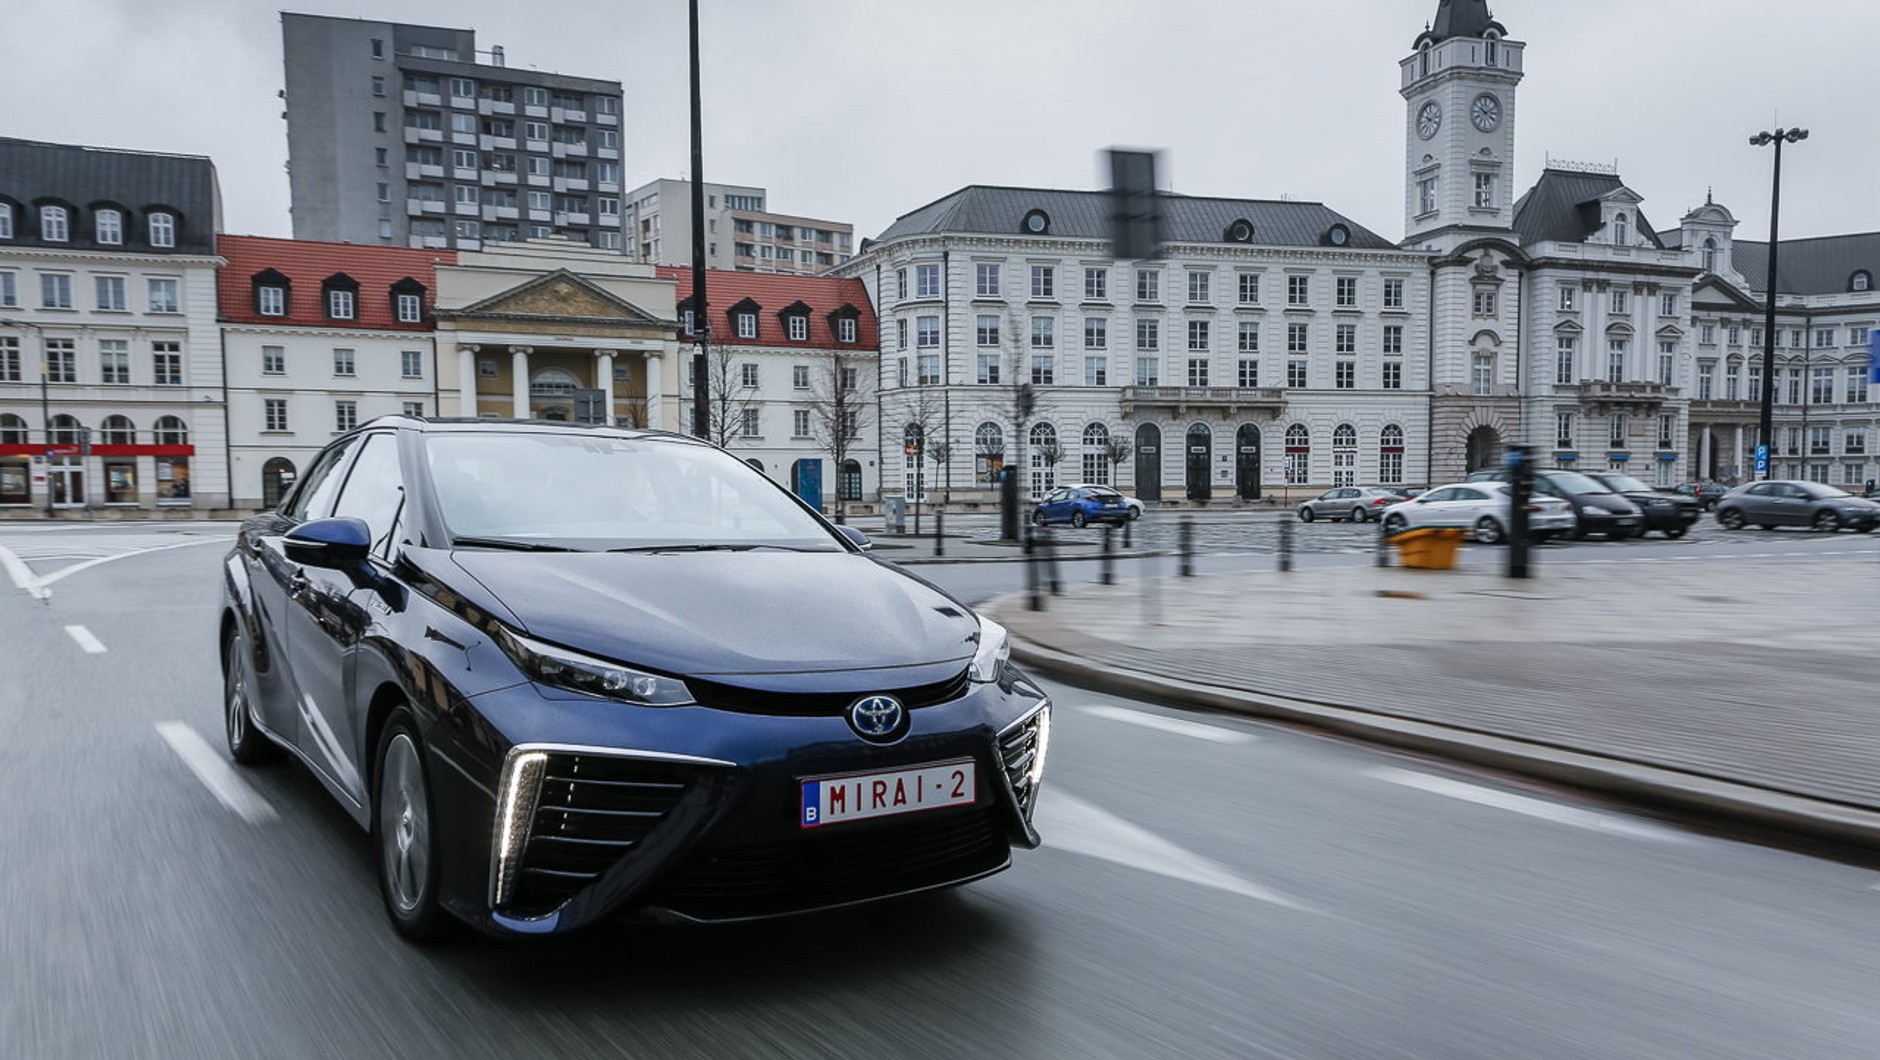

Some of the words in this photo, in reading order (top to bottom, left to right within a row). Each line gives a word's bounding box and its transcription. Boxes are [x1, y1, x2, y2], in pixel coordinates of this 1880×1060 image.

[1758, 446, 1765, 456] P
[1757, 460, 1765, 470] P
[806, 807, 817, 821] B
